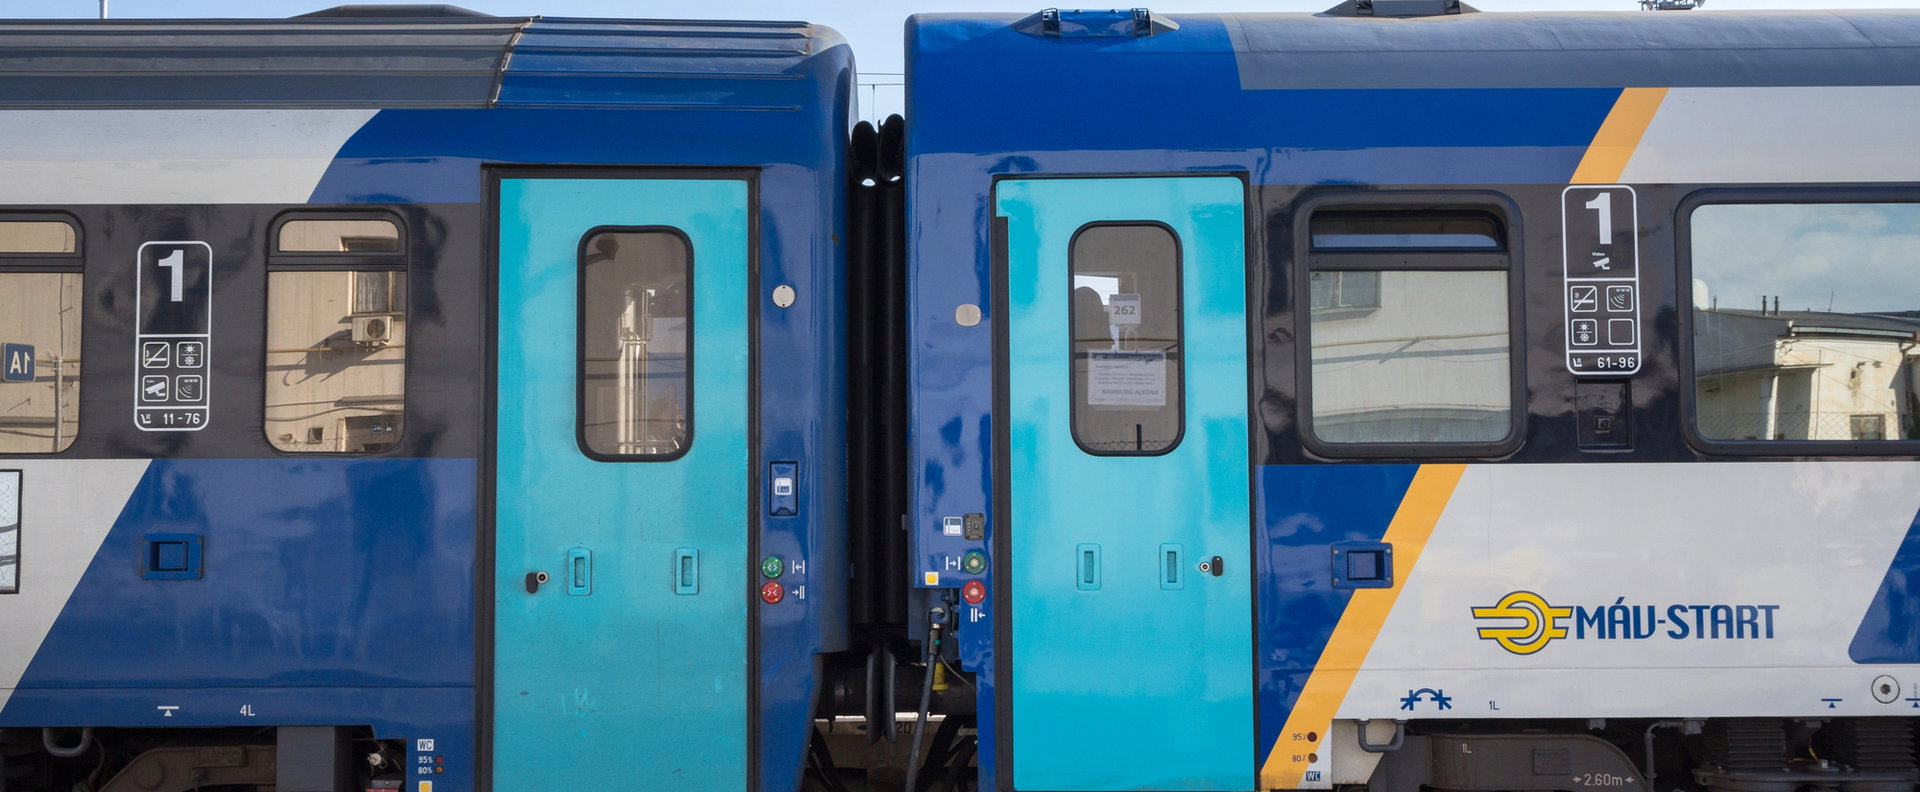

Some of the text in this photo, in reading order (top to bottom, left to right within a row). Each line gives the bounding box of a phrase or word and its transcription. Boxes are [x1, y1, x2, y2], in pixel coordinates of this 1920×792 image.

[1585, 192, 1612, 244] 1
[158, 249, 184, 302] 1
[1114, 305, 1136, 315] 262
[1597, 356, 1635, 369] 61-96
[163, 412, 200, 425] 11-76
[1576, 596, 1780, 639] MÁV-START
[239, 704, 256, 716] 4L
[1489, 700, 1500, 710] 1L
[419, 740, 433, 750] WC
[418, 755, 433, 764] 95%
[418, 766, 433, 775] 80%
[1307, 771, 1320, 781] WC
[1583, 773, 1623, 787] 2.60m
